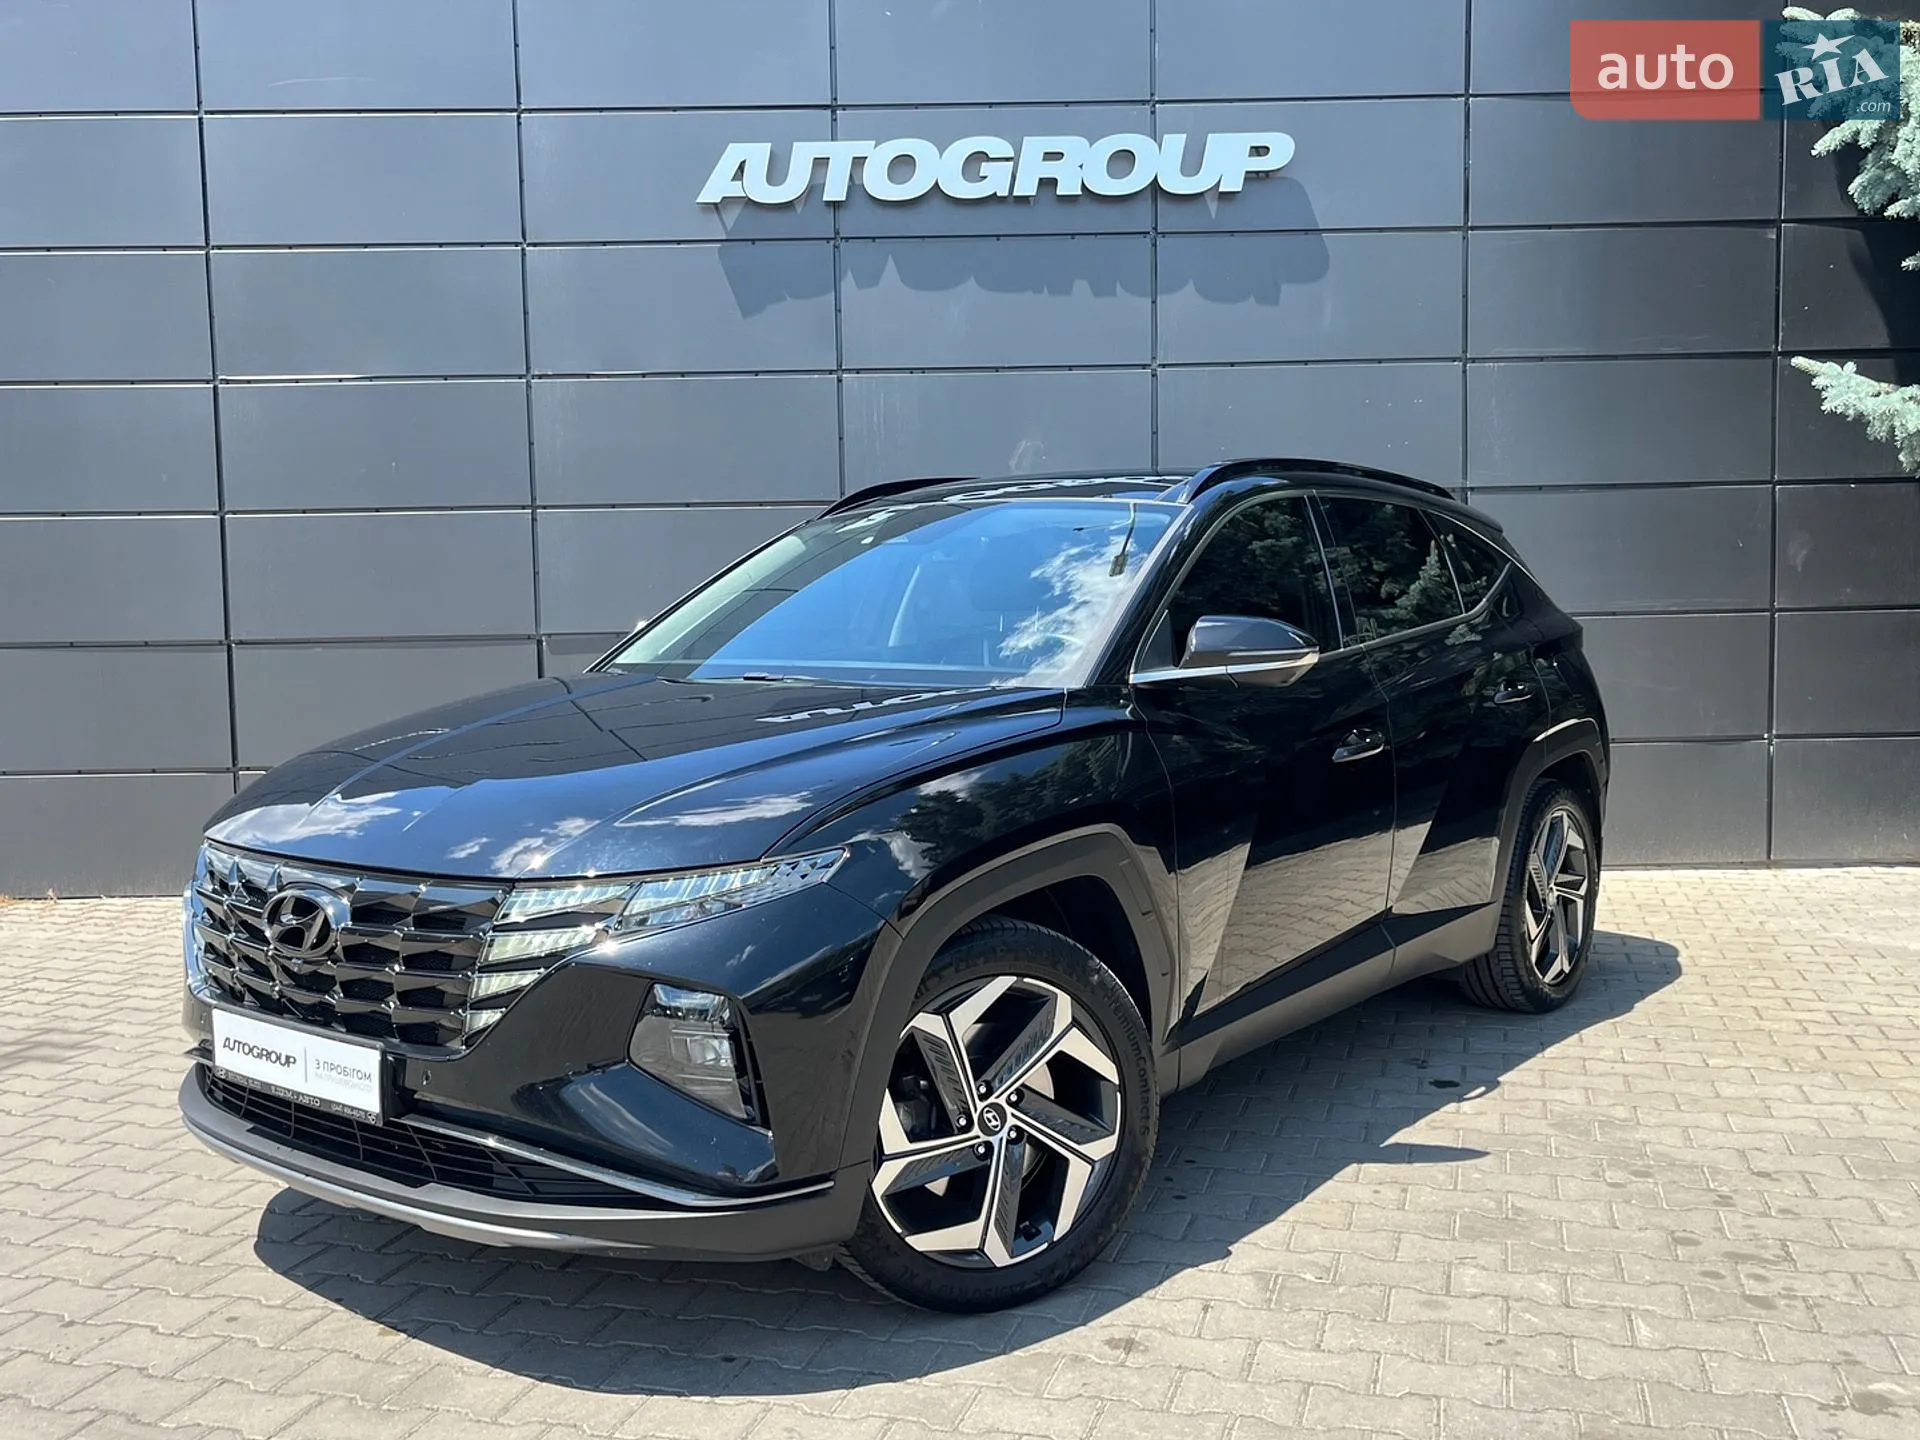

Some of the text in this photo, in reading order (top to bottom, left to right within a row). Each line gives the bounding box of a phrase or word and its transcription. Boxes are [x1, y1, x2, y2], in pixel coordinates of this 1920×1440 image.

[696, 132, 1295, 205] AUTOGROUP
[223, 1037, 296, 1069] AUTOGROUP
[322, 1060, 373, 1084] ПРОБІГОМ
